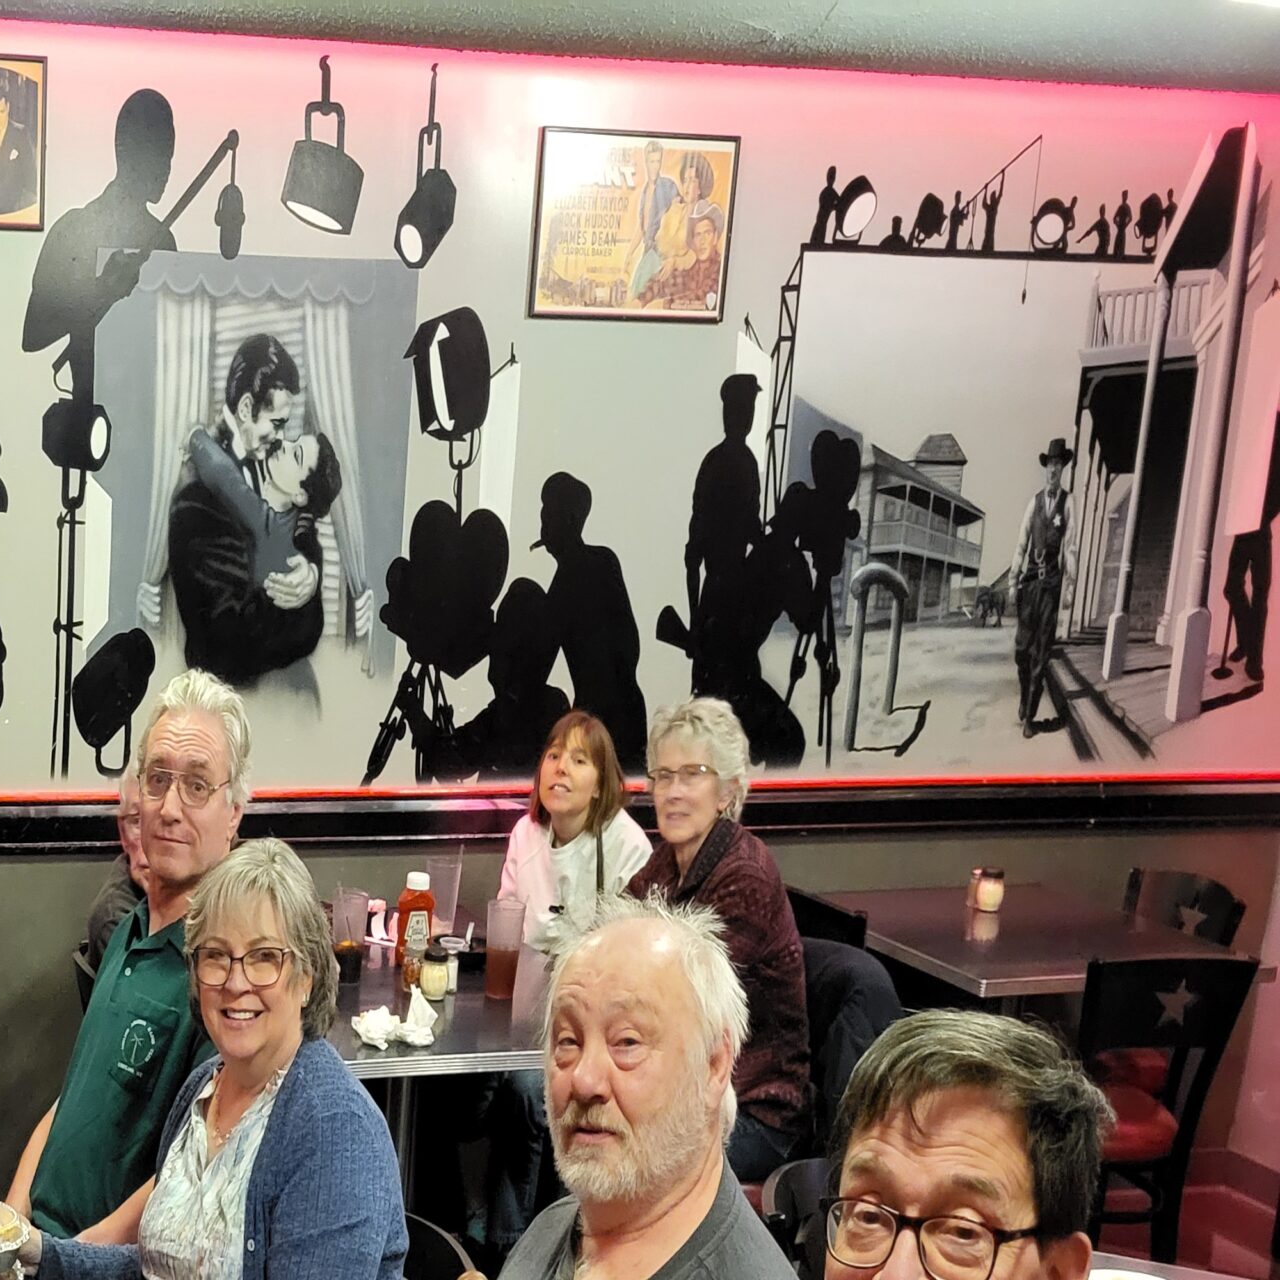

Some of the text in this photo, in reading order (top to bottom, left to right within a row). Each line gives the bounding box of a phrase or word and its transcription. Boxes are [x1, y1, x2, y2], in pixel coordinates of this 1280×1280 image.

[555, 195, 629, 212] ELIZABETH TAYLOR
[559, 212, 621, 229] ROCK HUDSON
[559, 230, 617, 247] JAMES DEAN
[591, 247, 612, 257] BAKER
